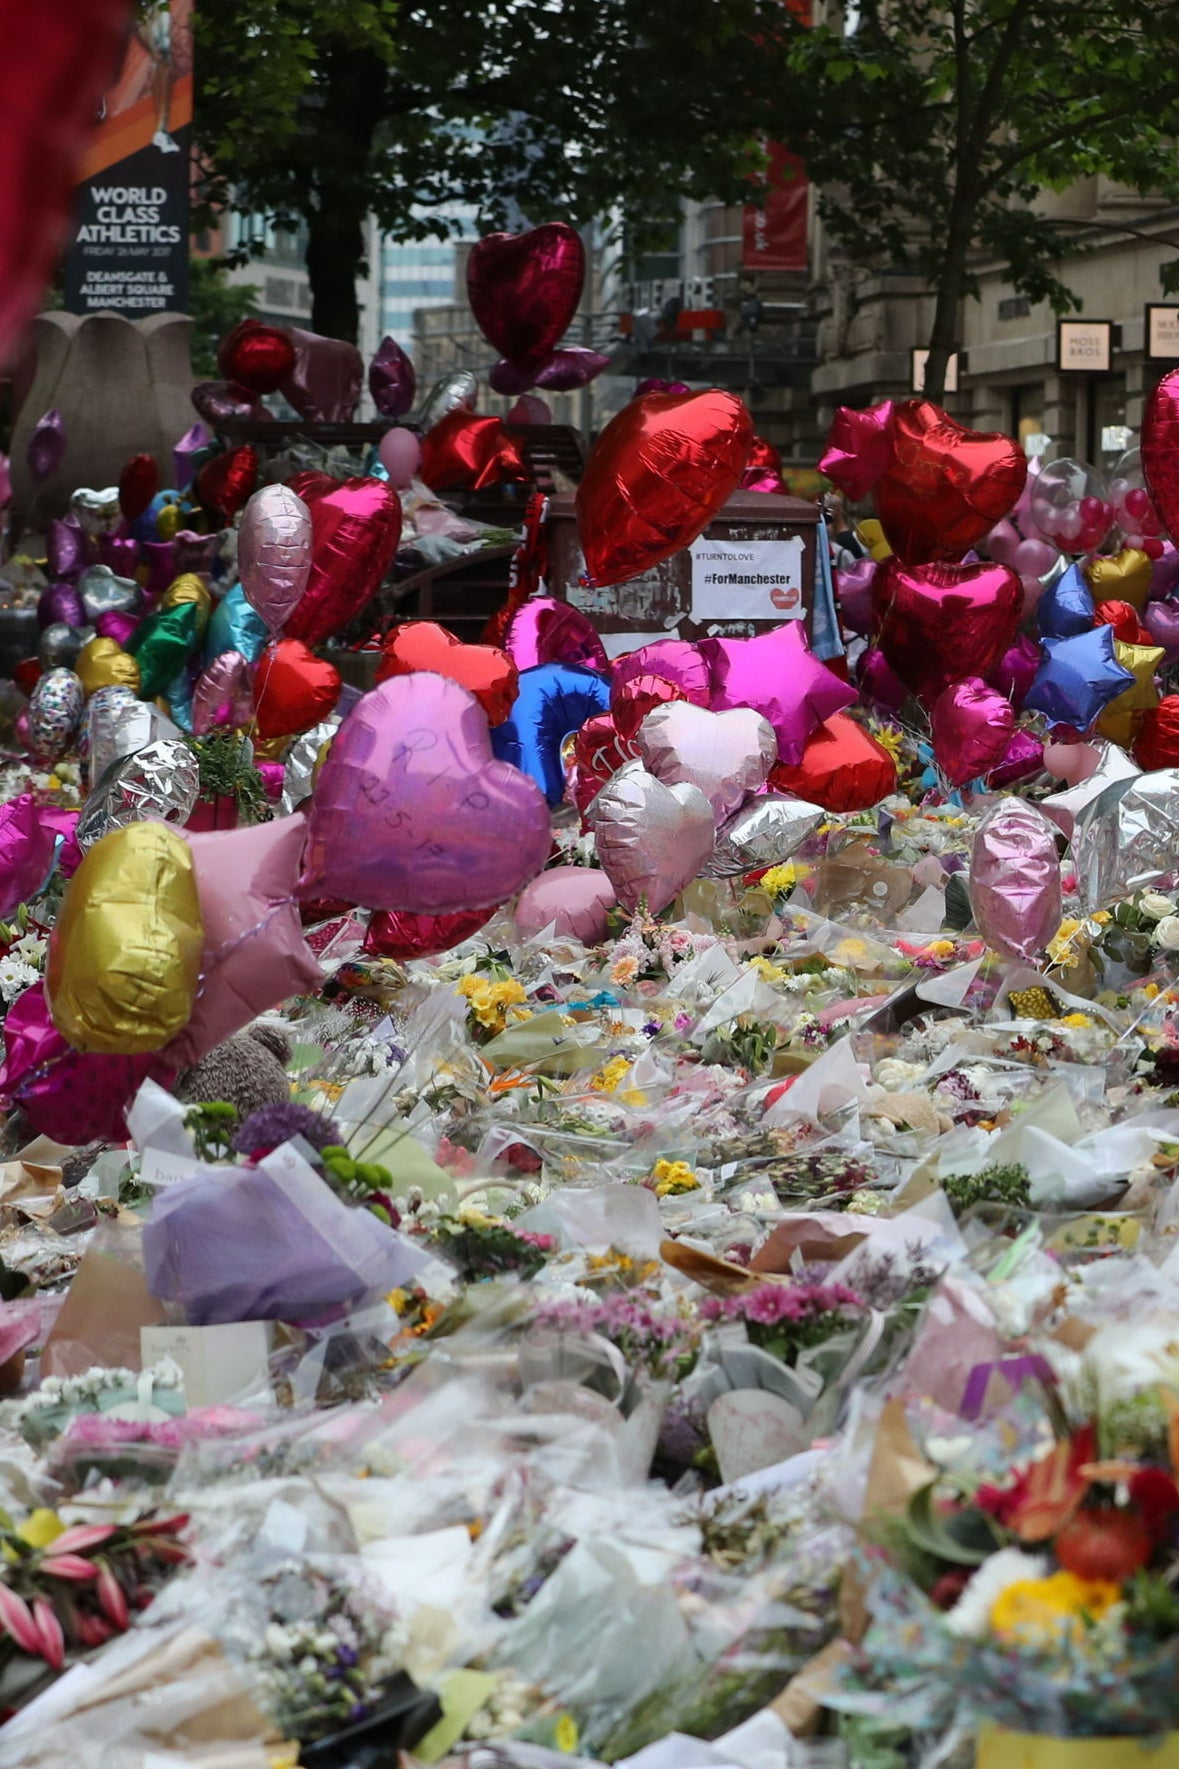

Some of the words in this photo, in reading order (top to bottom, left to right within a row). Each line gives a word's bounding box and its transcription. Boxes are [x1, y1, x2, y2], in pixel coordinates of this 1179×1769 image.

[90, 186, 168, 205] WORLD
[96, 206, 160, 223] CLASS
[76, 225, 181, 243] ATHLETICS
[86, 271, 156, 283] DEANSGATE
[157, 271, 168, 283] &
[79, 284, 125, 296] ALBERT
[126, 284, 175, 296] SQUARE
[86, 297, 167, 308] MANCHESTER
[1069, 337, 1101, 347] MOSS
[696, 553, 755, 562] #TURNTOLOVE
[704, 574, 791, 585] #ForManchester
